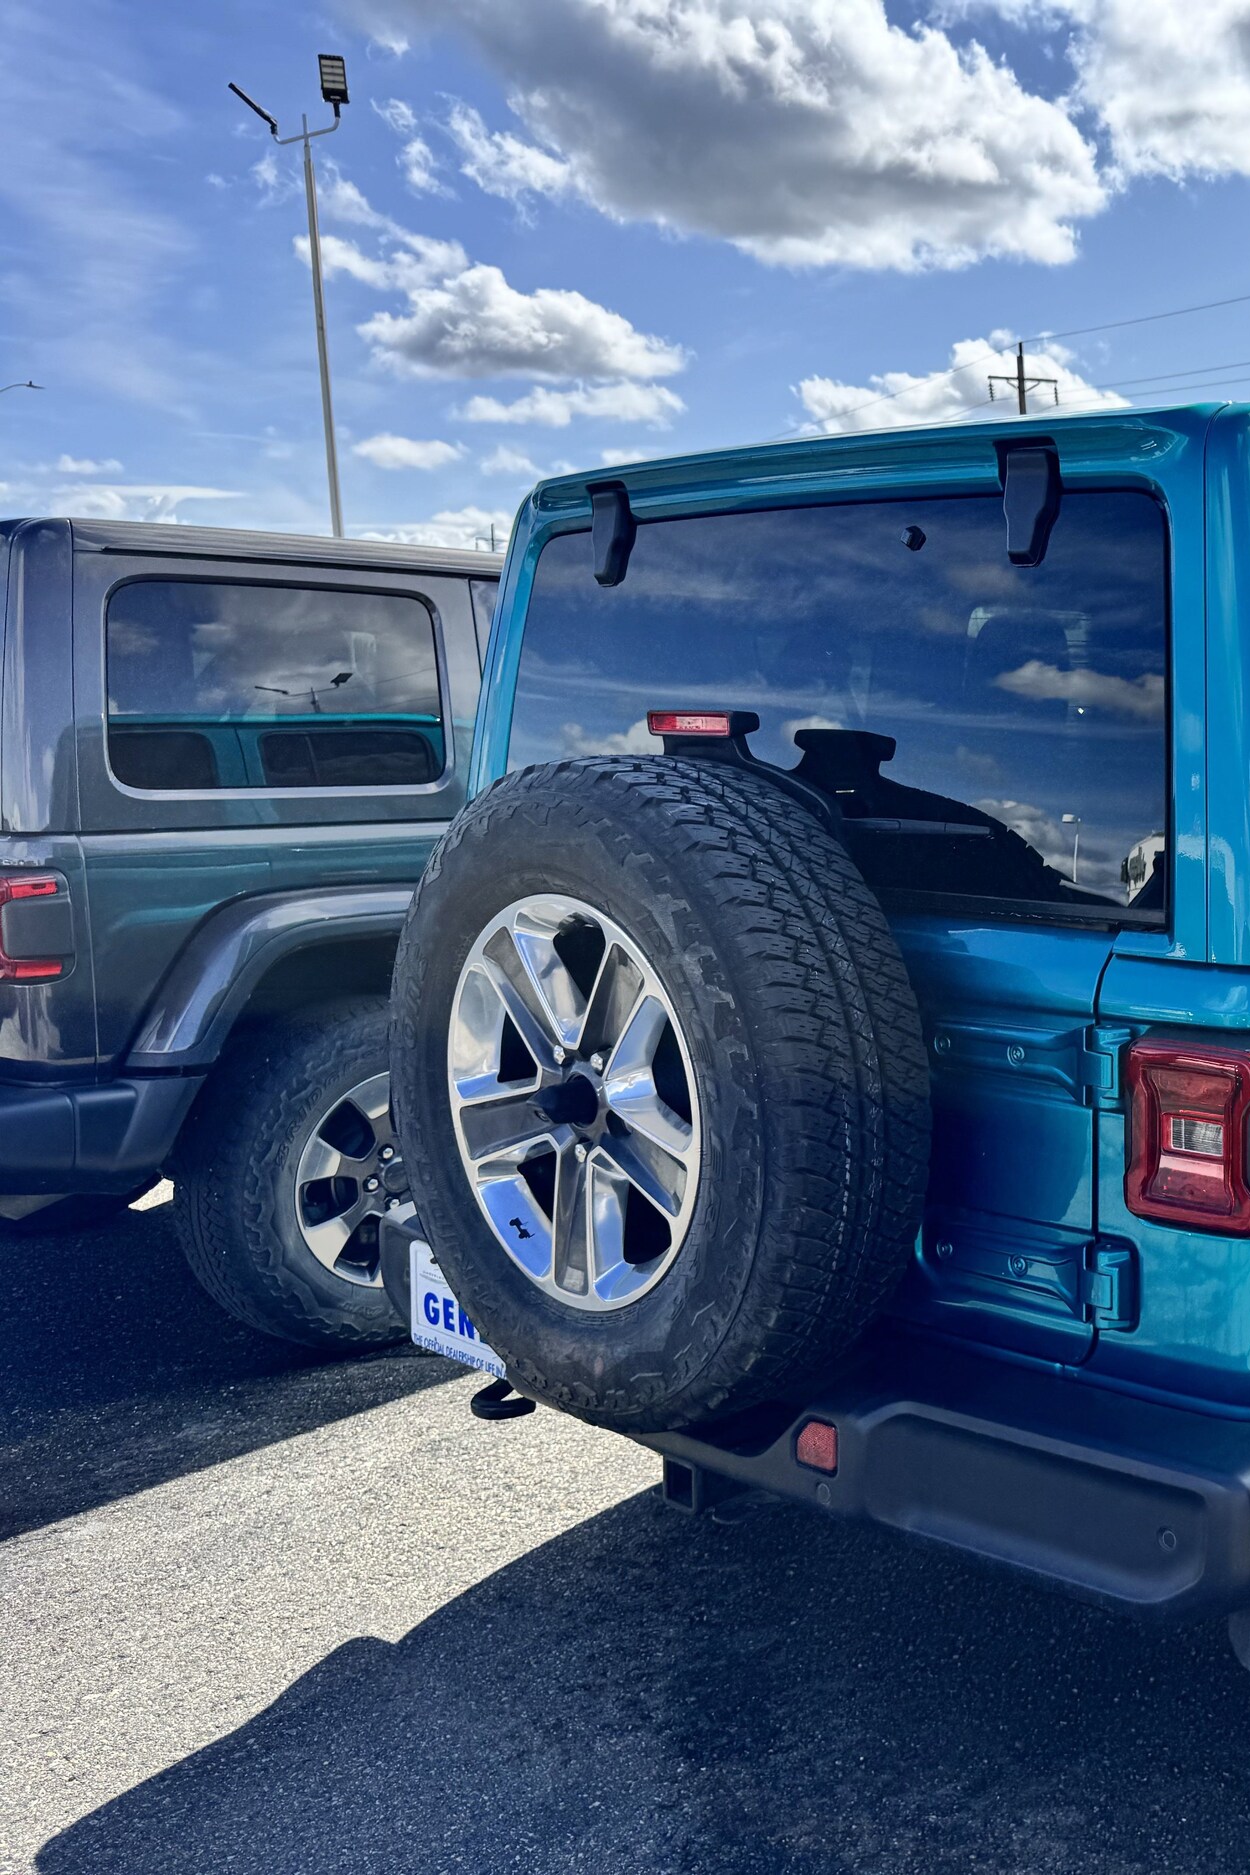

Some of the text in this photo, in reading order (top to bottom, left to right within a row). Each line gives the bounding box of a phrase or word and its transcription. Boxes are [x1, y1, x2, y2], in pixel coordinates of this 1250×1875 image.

[413, 1333, 423, 1345] THE
[445, 1346, 476, 1367] DEALERSHIP
[476, 1357, 485, 1370] OF
[485, 1361, 495, 1374] LIFE
